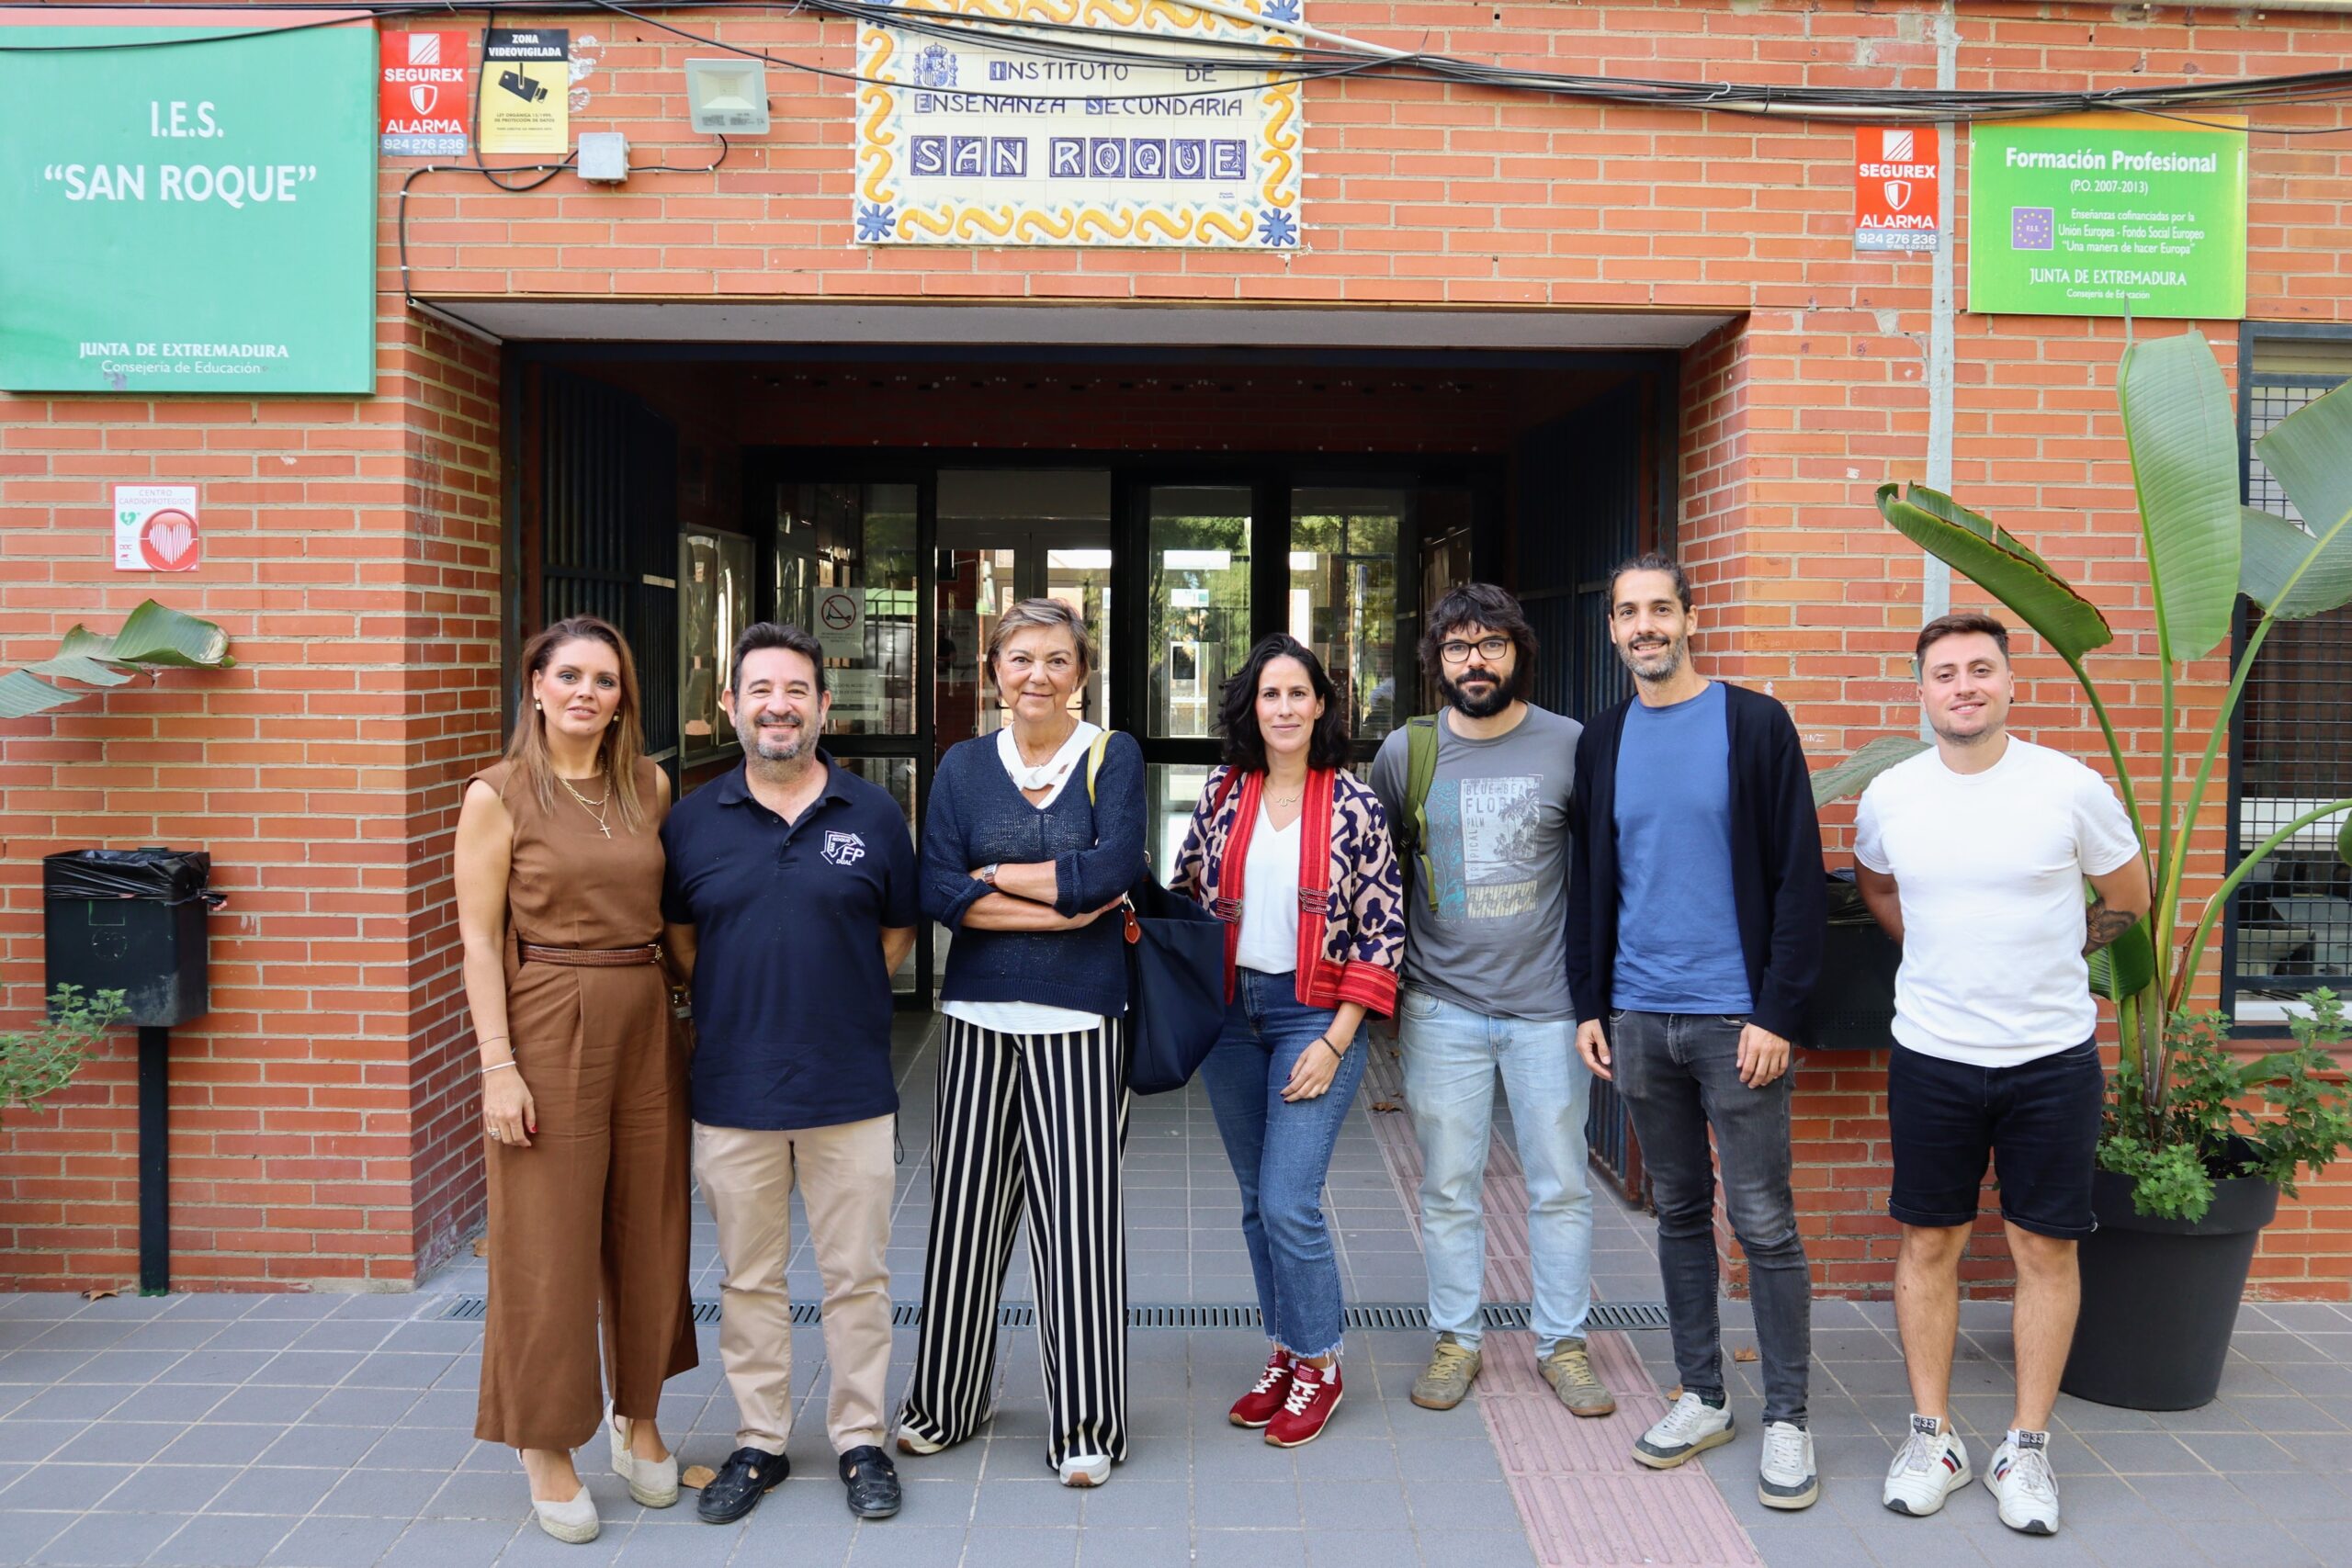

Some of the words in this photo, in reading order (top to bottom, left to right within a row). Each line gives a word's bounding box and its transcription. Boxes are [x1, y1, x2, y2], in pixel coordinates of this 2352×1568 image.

[512, 34, 539, 45] ZONA
[488, 46, 562, 59] VIDEOVIGILADA
[384, 68, 464, 83] SEGUREX
[989, 61, 1129, 81] INSTITUTO
[1185, 63, 1217, 82] DE
[1086, 95, 1242, 116] SECUNDARIA
[151, 101, 225, 138] I.E.S.
[386, 119, 463, 133] ALARMA
[383, 139, 410, 150] 924
[412, 139, 436, 150] 276
[438, 139, 464, 150] 236
[910, 135, 1028, 177] SAN
[1049, 137, 1248, 180] ROQUE
[2006, 147, 2107, 171] Formación
[2112, 149, 2217, 173] Profesional
[1859, 164, 1936, 178] SEGUREX
[2070, 179, 2093, 195] (P.O.
[2094, 179, 2149, 196] 2007-2013)
[1860, 214, 1935, 229] ALARMA
[2071, 209, 2116, 220] Enseñanzas
[2118, 210, 2169, 221] cofinanciadas
[2171, 213, 2187, 224] por
[2188, 211, 2195, 222] la
[1858, 233, 1883, 243] 924
[1886, 233, 1910, 244] 276
[1912, 234, 1937, 245] 236
[2058, 223, 2082, 236] Unión
[2084, 224, 2115, 240] Europea
[2122, 225, 2147, 238] Fondo
[2148, 226, 2170, 239] Social
[2172, 226, 2205, 242] Europeo
[2086, 243, 2119, 253] manera
[2120, 242, 2132, 253] de
[2133, 242, 2158, 254] hacer
[2030, 268, 2071, 285] JUNTA
[2075, 269, 2089, 283] DE
[2093, 269, 2188, 286] EXTREMADURA
[2105, 289, 2115, 299] de
[80, 342, 130, 359] JUNTA
[136, 343, 157, 357] DE
[163, 344, 289, 358] EXTREMADURA
[101, 359, 172, 376] Consejería
[175, 360, 191, 373] de
[195, 360, 262, 375] Educación
[1466, 784, 1494, 795] BLUE
[841, 846, 865, 862] FP
[1468, 829, 1479, 878] TRPICAL
[1921, 1418, 1936, 1428] 33
[2030, 1434, 2044, 1444] 33
